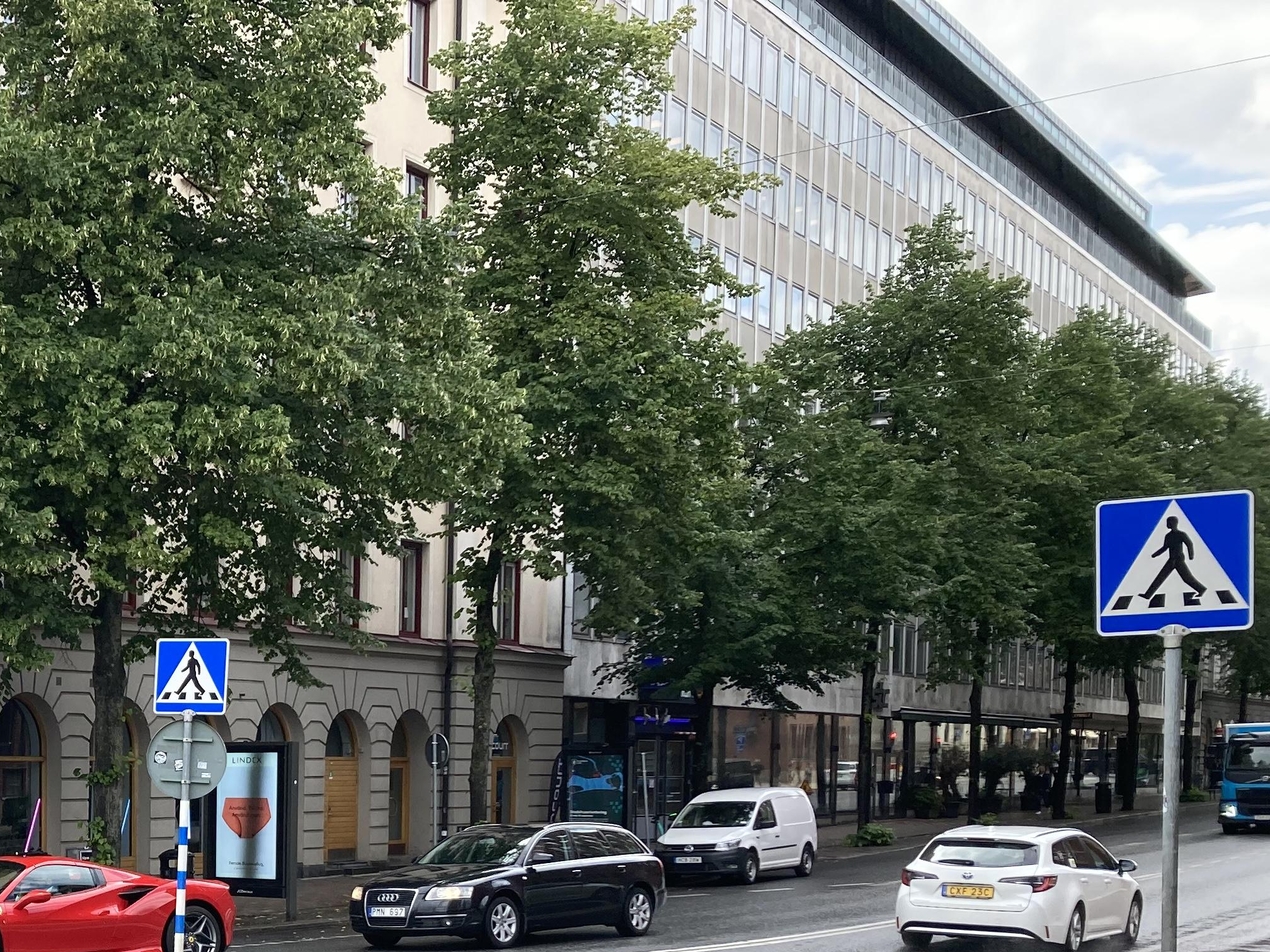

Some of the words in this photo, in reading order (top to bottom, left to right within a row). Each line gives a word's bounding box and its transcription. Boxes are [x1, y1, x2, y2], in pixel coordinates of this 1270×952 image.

[231, 756, 263, 764] LINDEX
[949, 886, 968, 895] CXF
[971, 887, 991, 896] 23C
[372, 907, 385, 916] PMN
[389, 908, 404, 916] 697
